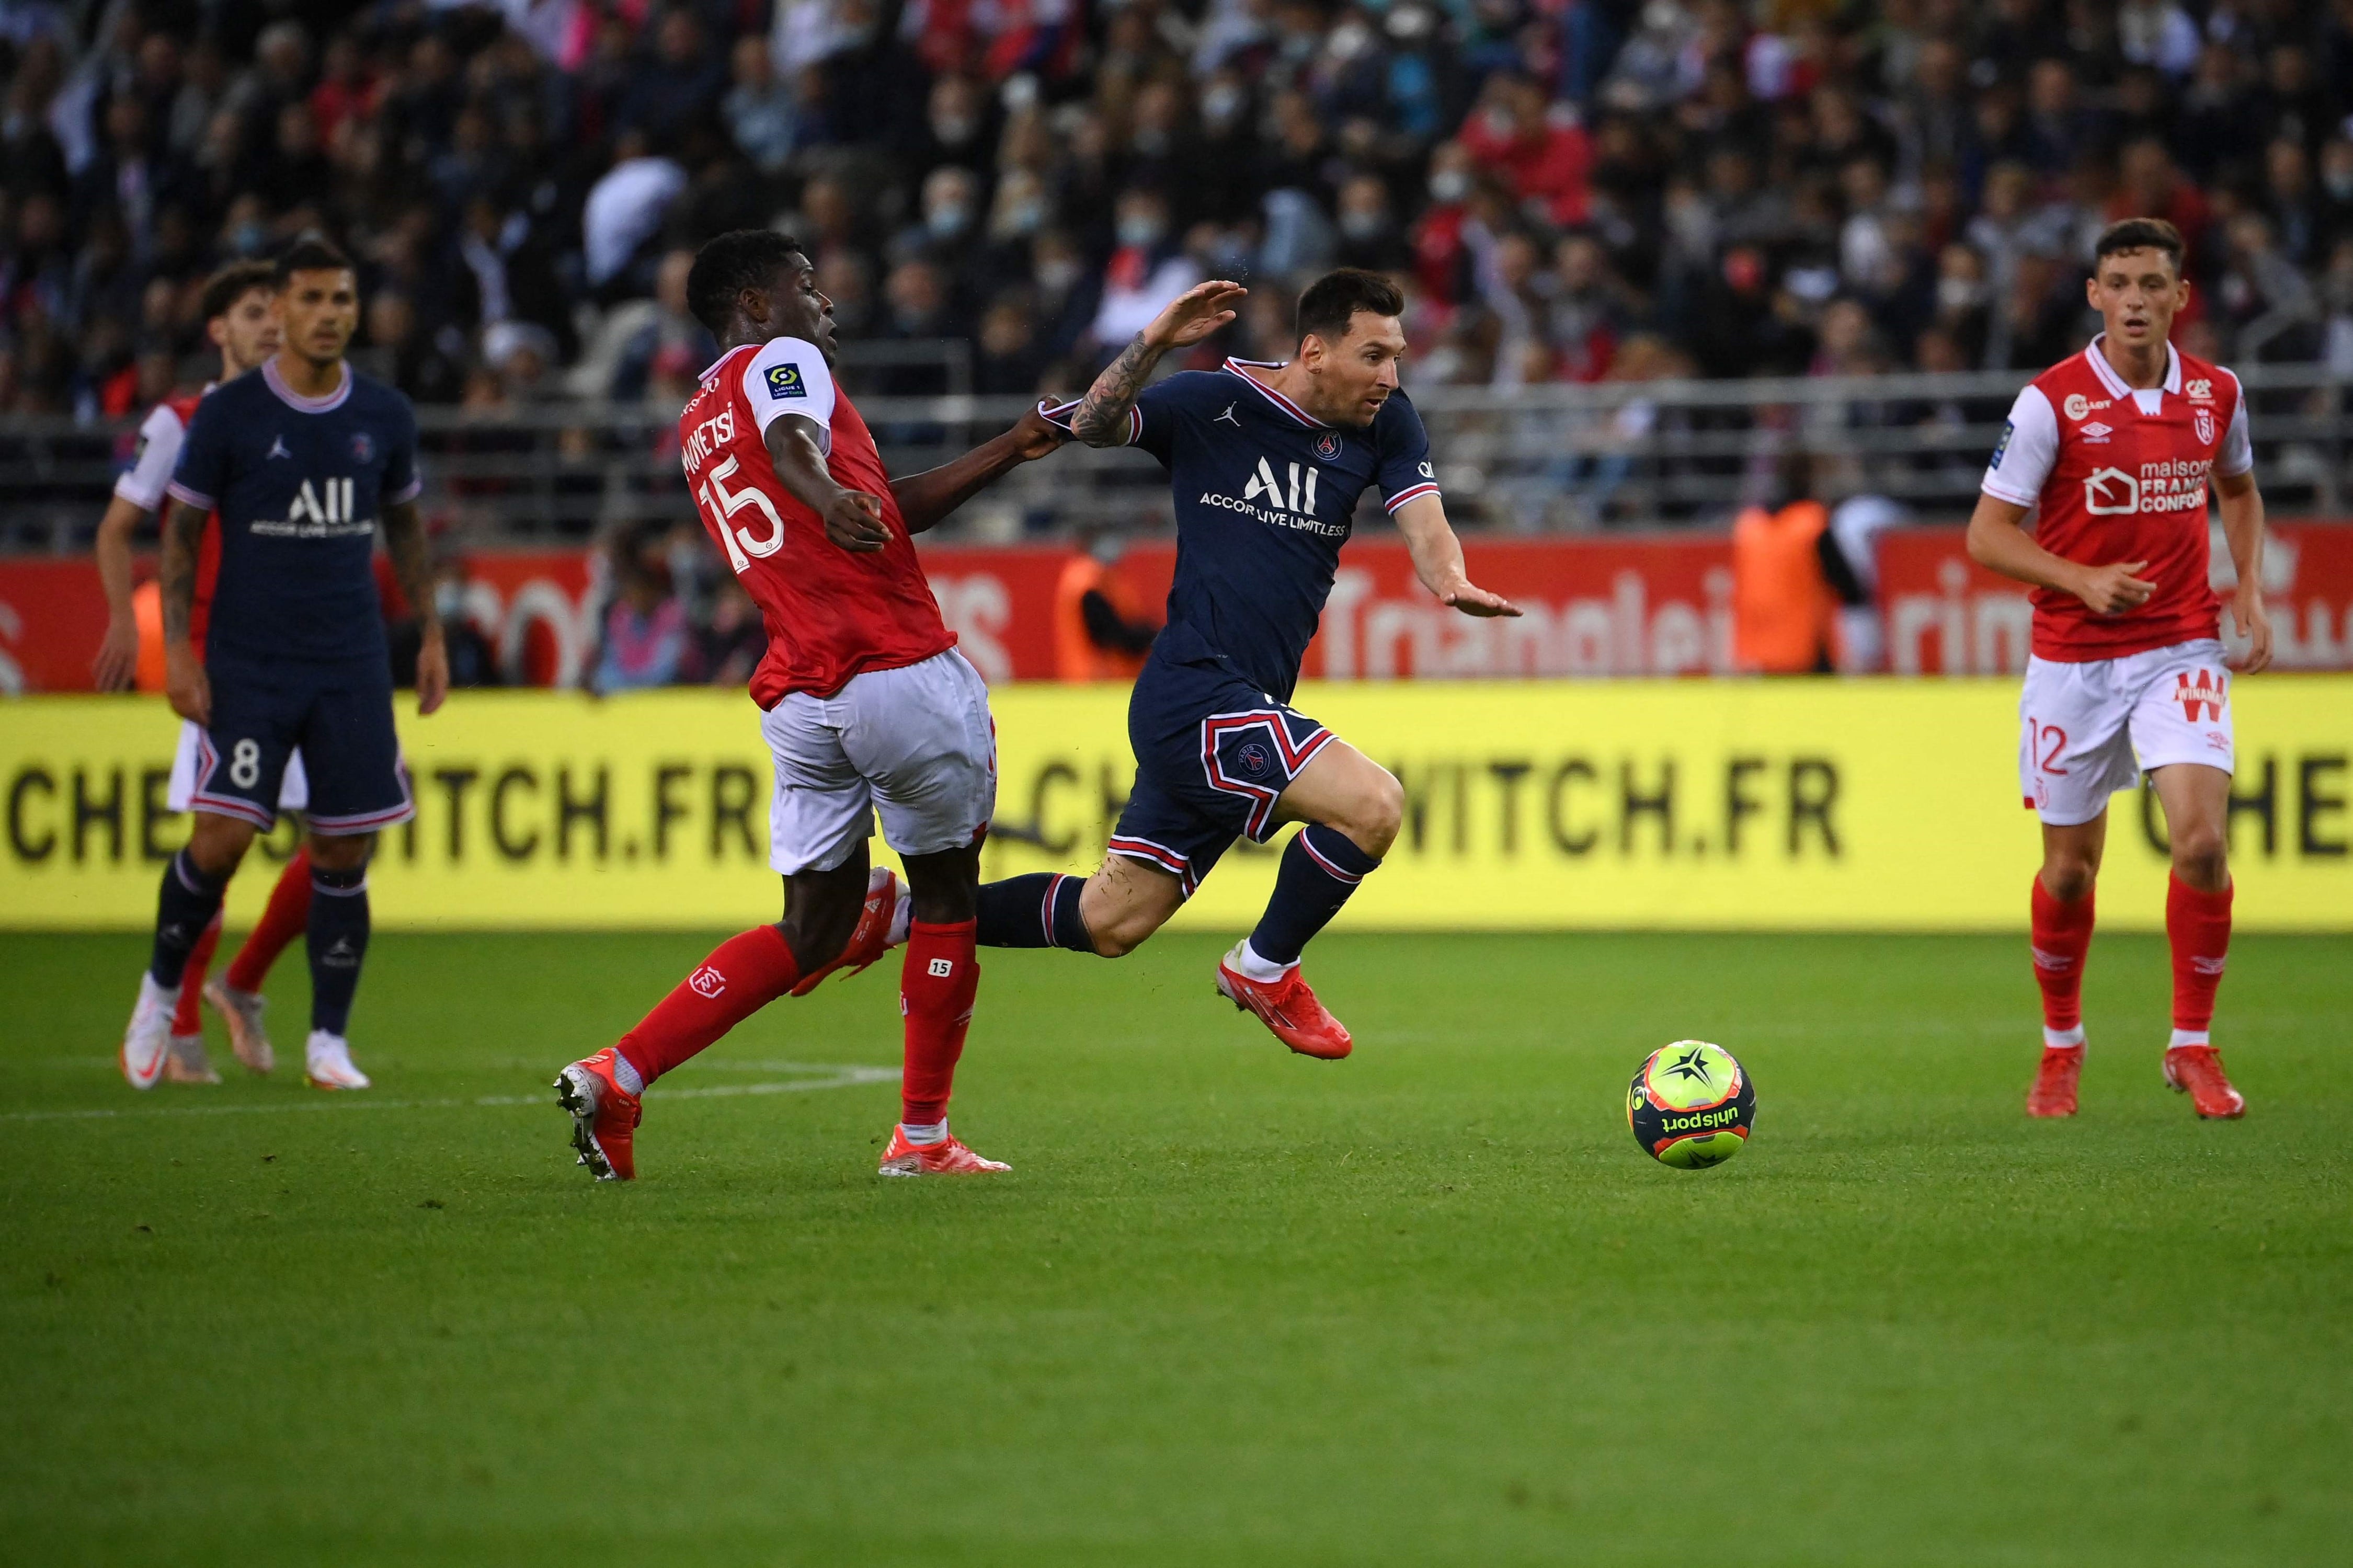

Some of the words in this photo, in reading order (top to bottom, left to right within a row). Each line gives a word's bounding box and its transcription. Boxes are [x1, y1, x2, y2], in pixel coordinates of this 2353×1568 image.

[699, 452, 784, 575] 15
[1200, 493, 1254, 516] ACCOR
[1256, 508, 1287, 527] LIVE
[1289, 515, 1346, 537] LIMITLESS
[230, 738, 260, 789] 8
[1239, 745, 1255, 763] PARIS
[2029, 716, 2069, 775] 12
[932, 962, 948, 974] 15
[1661, 1106, 1739, 1133] uhlsport
